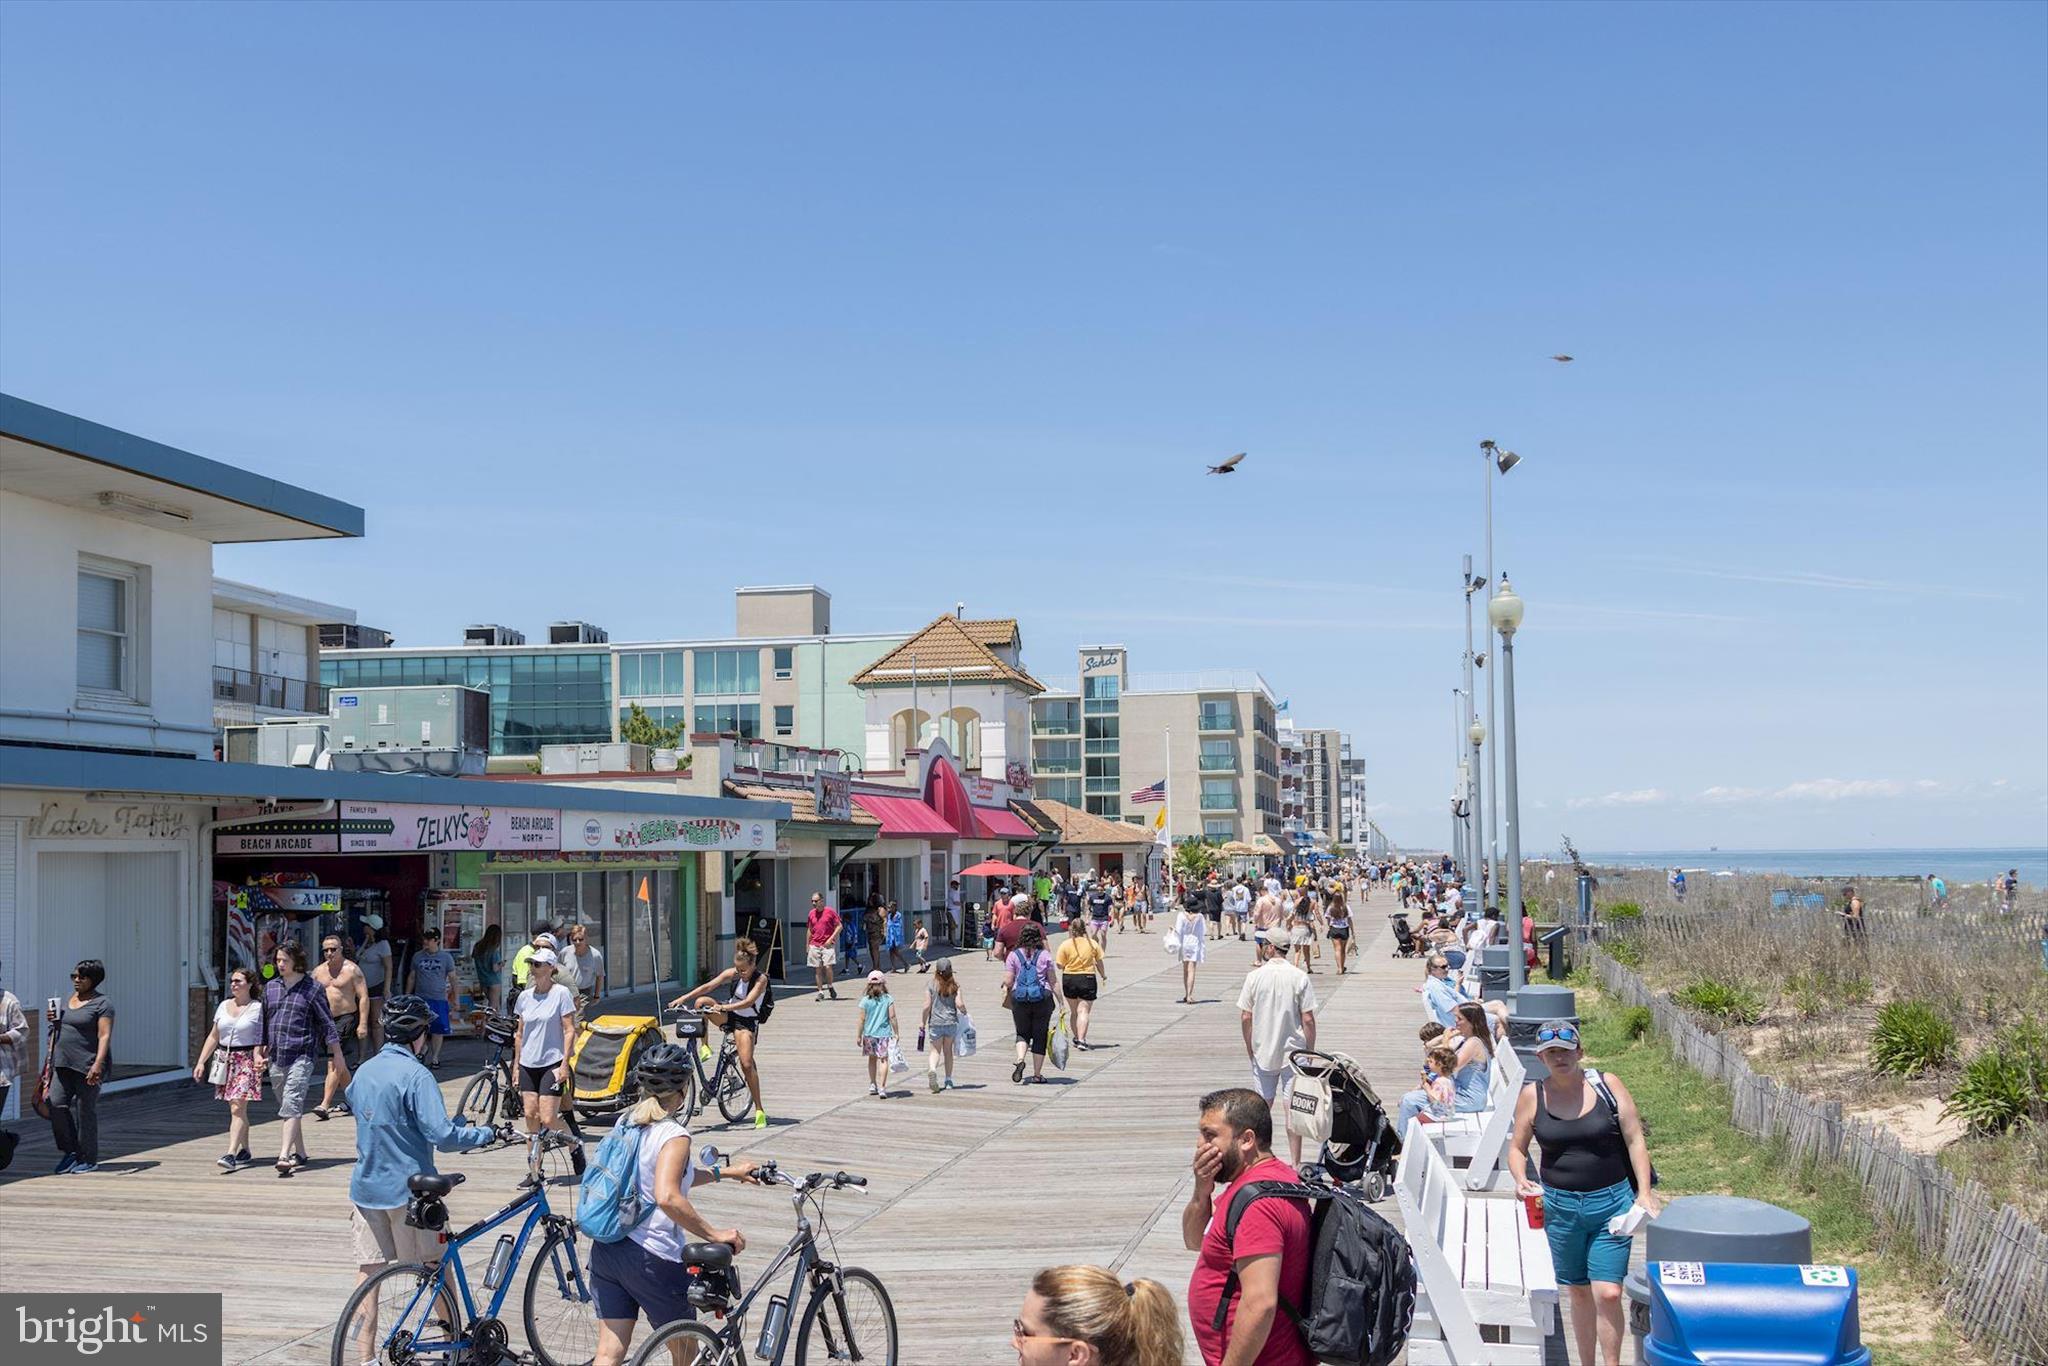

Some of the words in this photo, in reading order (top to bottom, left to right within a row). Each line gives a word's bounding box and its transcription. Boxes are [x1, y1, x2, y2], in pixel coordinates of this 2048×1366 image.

[1083, 652, 1118, 672] Sands
[28, 802, 109, 837] Water
[115, 802, 189, 840] Taffy
[417, 805, 469, 849] ZELKY'S
[511, 816, 530, 830] BEACH
[532, 816, 554, 831] ARCADE
[240, 838, 271, 850] BEACH
[274, 838, 312, 849] ARCADE
[522, 834, 543, 842] NORTH
